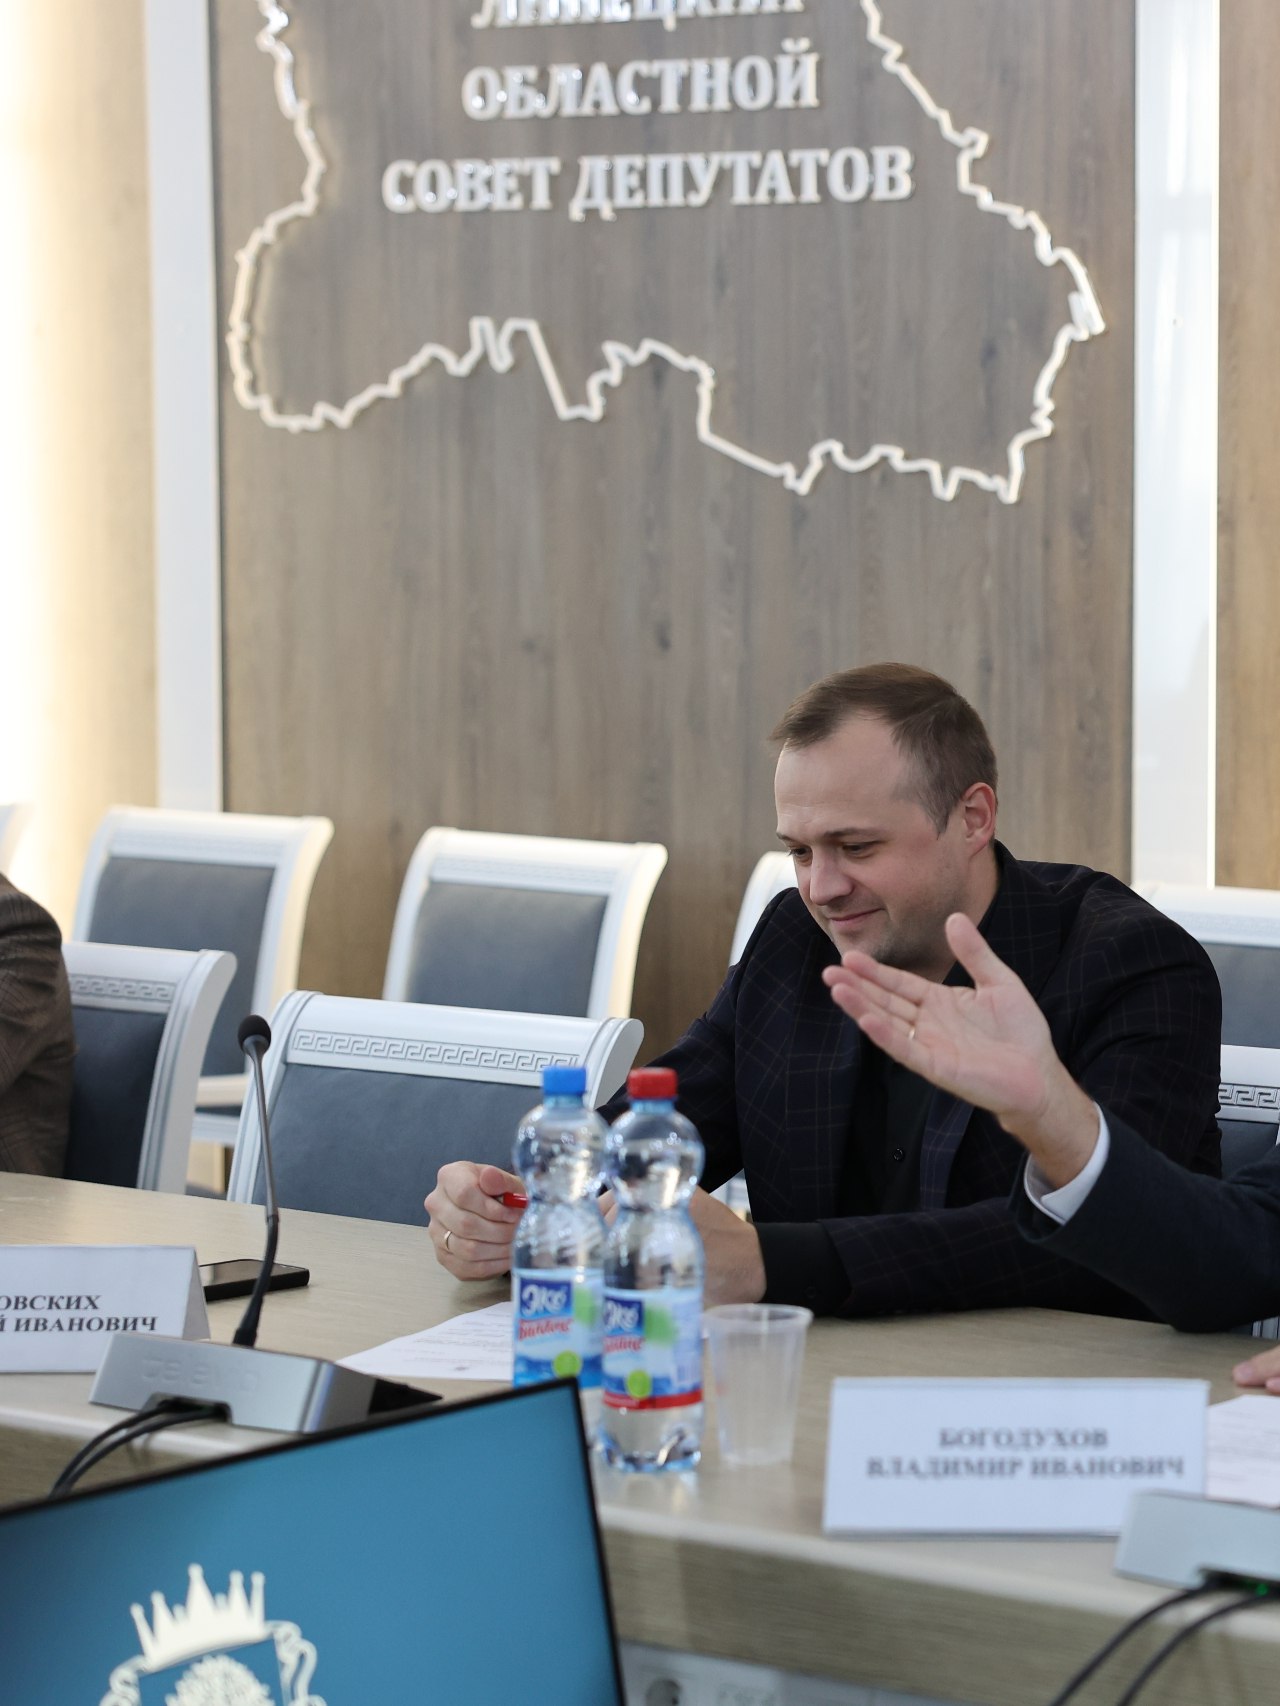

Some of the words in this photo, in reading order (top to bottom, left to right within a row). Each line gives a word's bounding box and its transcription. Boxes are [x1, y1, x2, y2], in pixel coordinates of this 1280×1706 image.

[461, 37, 820, 121] ОБЛАСТНОЙ
[381, 156, 561, 214] СОВЕТ
[569, 146, 914, 222] ДЕПУТАТОВ
[14, 1316, 158, 1332] ИВАНОВИЧ
[939, 1428, 1109, 1451] БОГОДУХОВ
[866, 1457, 1025, 1480] ВЛАДИМИР
[1030, 1456, 1186, 1478] ИВАНОВИЧ
